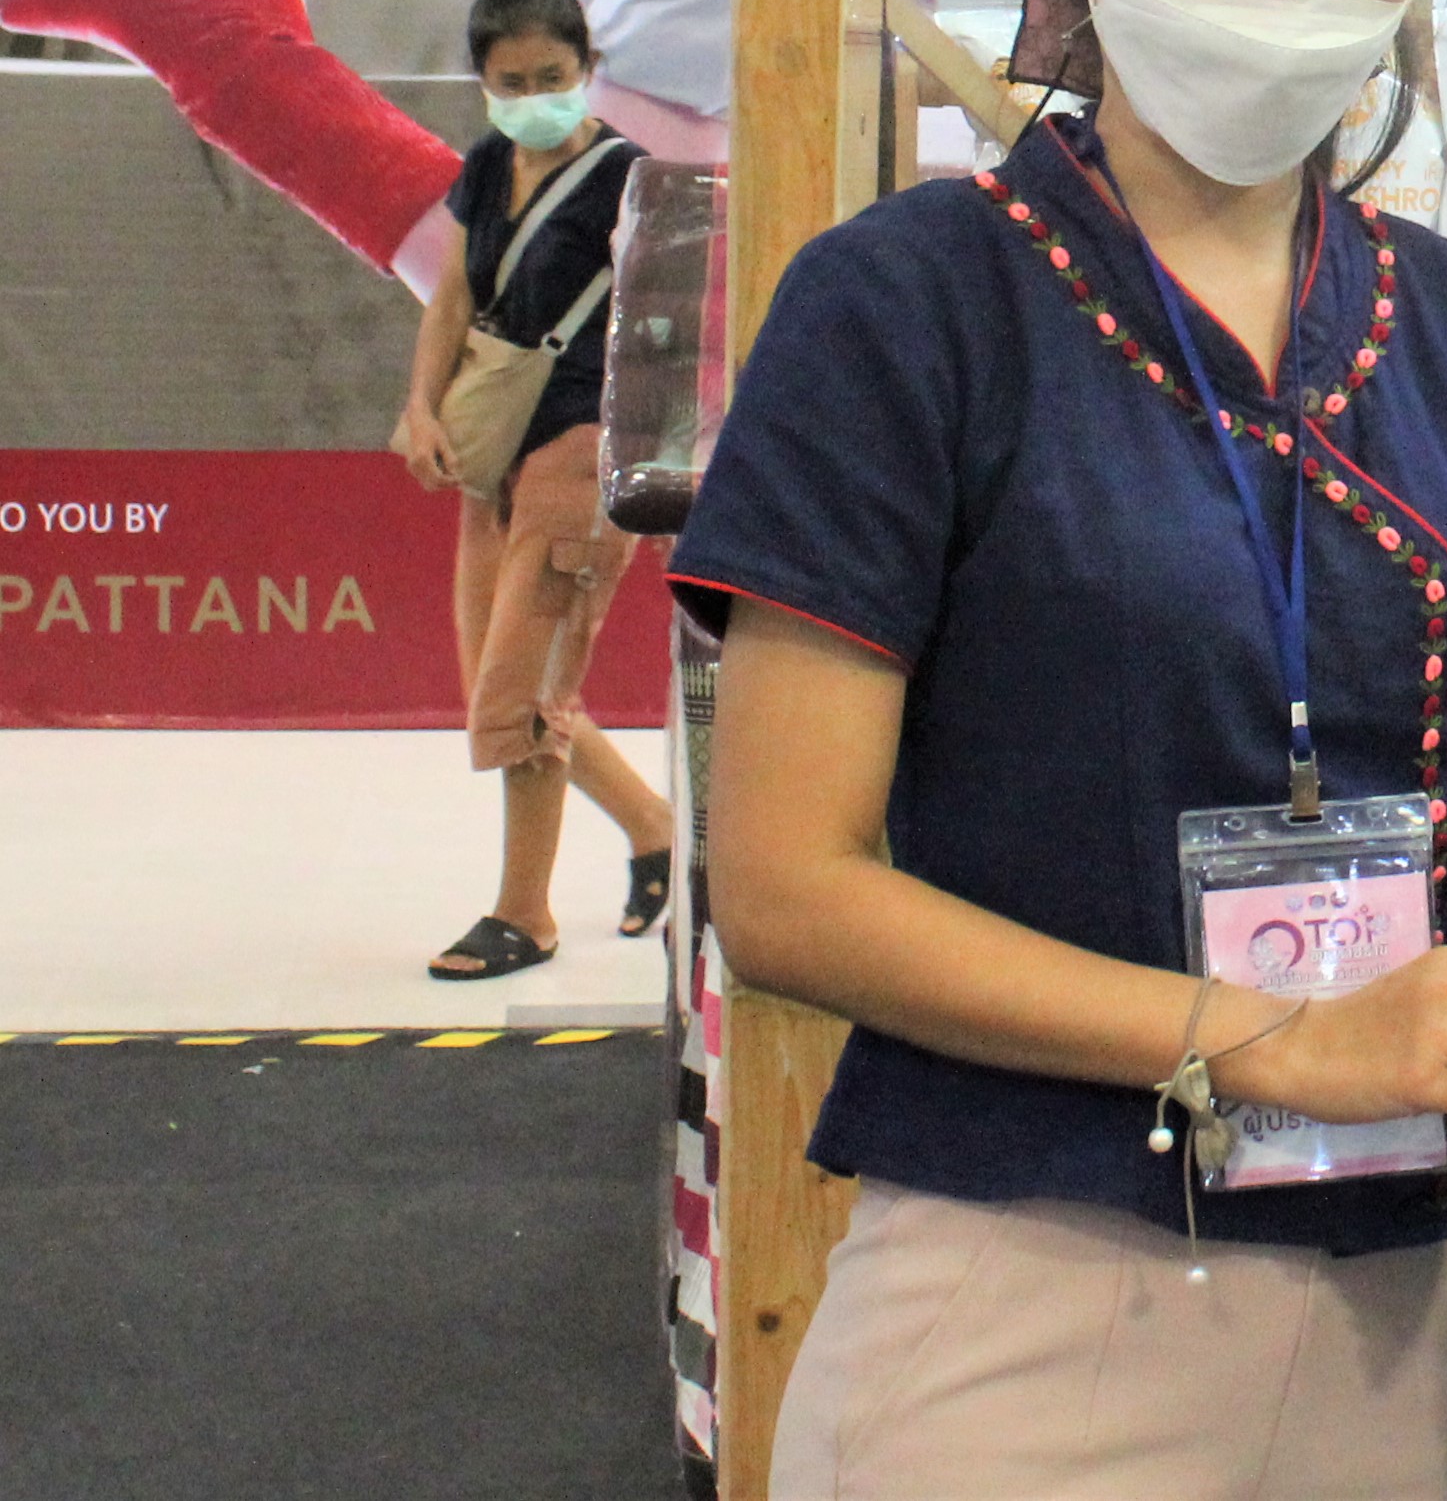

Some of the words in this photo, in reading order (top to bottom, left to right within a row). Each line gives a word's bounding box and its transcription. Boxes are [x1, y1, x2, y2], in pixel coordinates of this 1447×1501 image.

[37, 502, 114, 533] YOU
[125, 502, 169, 533] BY
[0, 574, 376, 634] PATTANA
